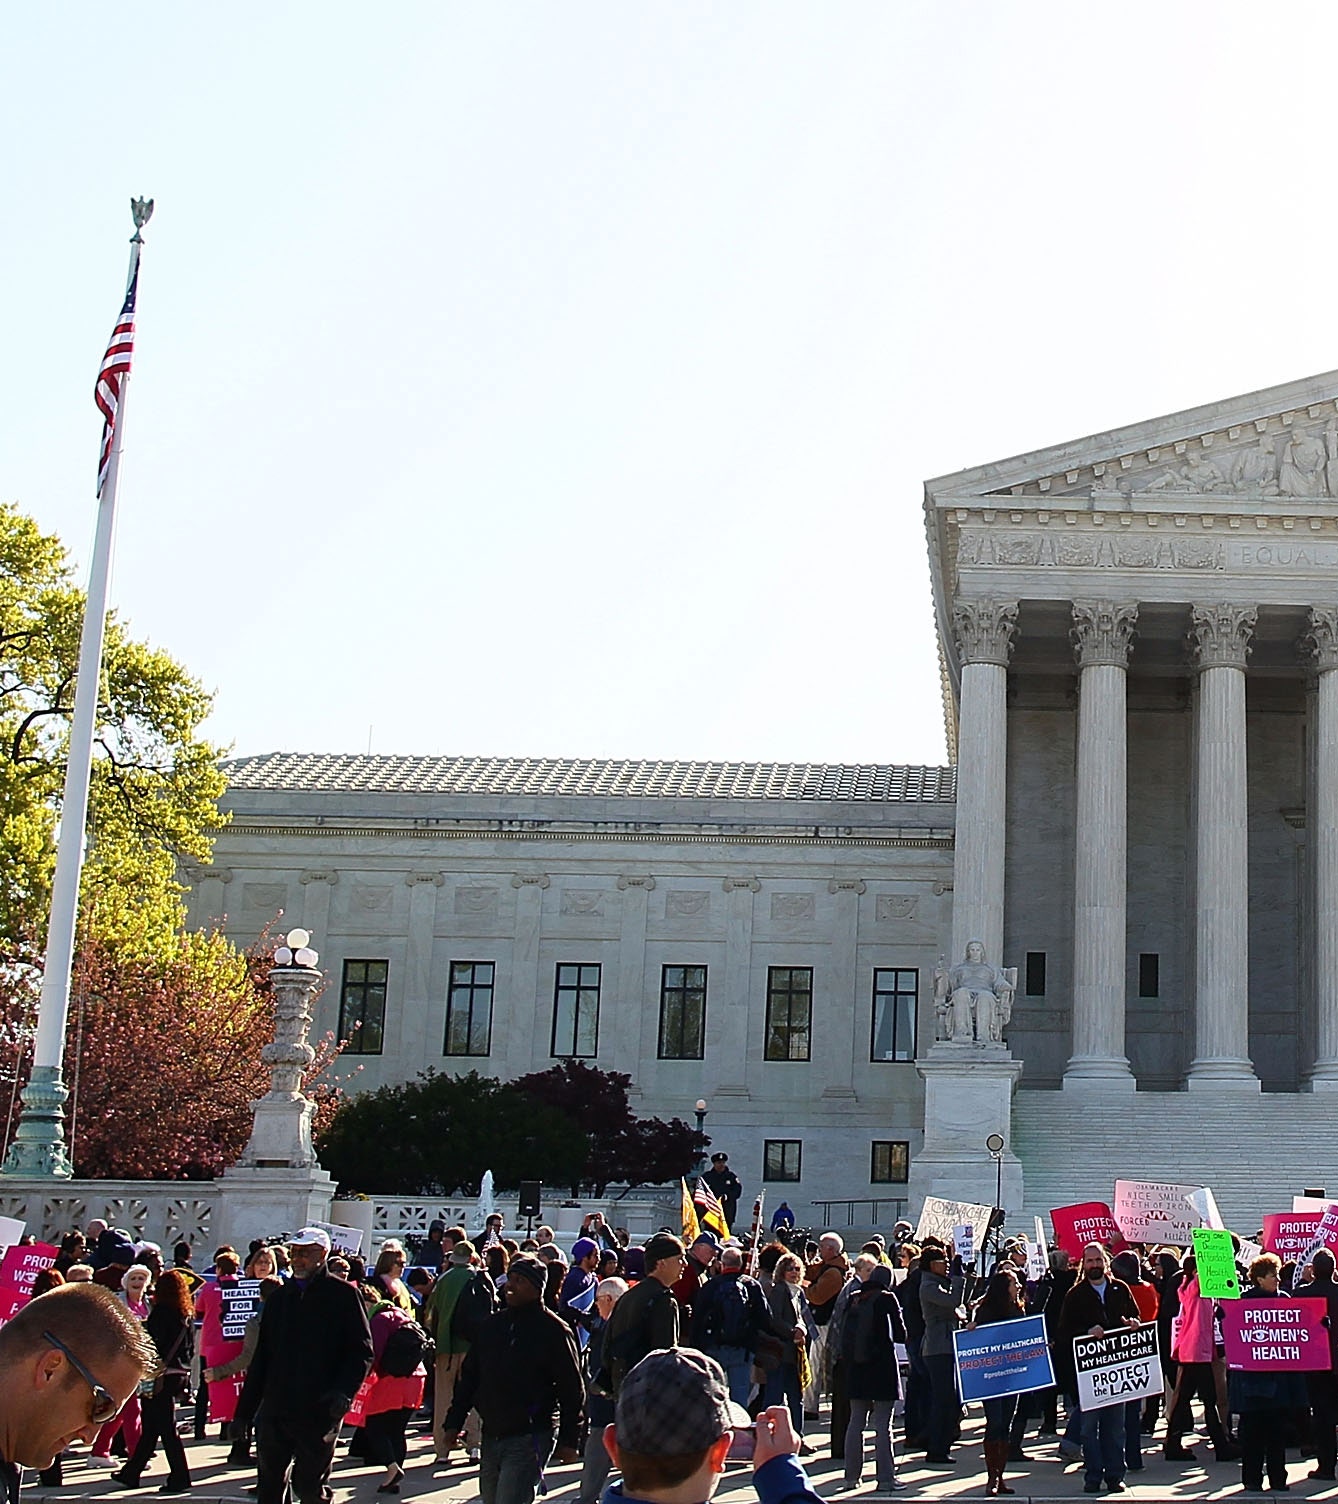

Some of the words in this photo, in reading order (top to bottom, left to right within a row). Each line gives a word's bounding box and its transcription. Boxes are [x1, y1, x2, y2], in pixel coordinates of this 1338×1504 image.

[1241, 546, 1324, 567] EQUAL
[1073, 1217, 1115, 1231] PROTECT
[1280, 1221, 1321, 1234] PROTEC
[1076, 1230, 1098, 1243] THE
[1164, 1231, 1193, 1242] RELIGIO
[1244, 1309, 1301, 1324] PROTECT
[1077, 1337, 1118, 1357] DON'T
[1120, 1328, 1155, 1347] DENY
[958, 1347, 989, 1358] PROTECT
[990, 1344, 1001, 1353] MY
[1081, 1358, 1094, 1369] MY
[1095, 1350, 1129, 1365] HEALTH
[1130, 1345, 1153, 1357] CARE
[1252, 1346, 1300, 1361] HEALTH
[959, 1355, 1003, 1371] PROTECT
[1005, 1352, 1023, 1364] THE
[1092, 1362, 1150, 1388] PROTECT
[1093, 1387, 1108, 1397] the
[1109, 1376, 1150, 1396] LAW
